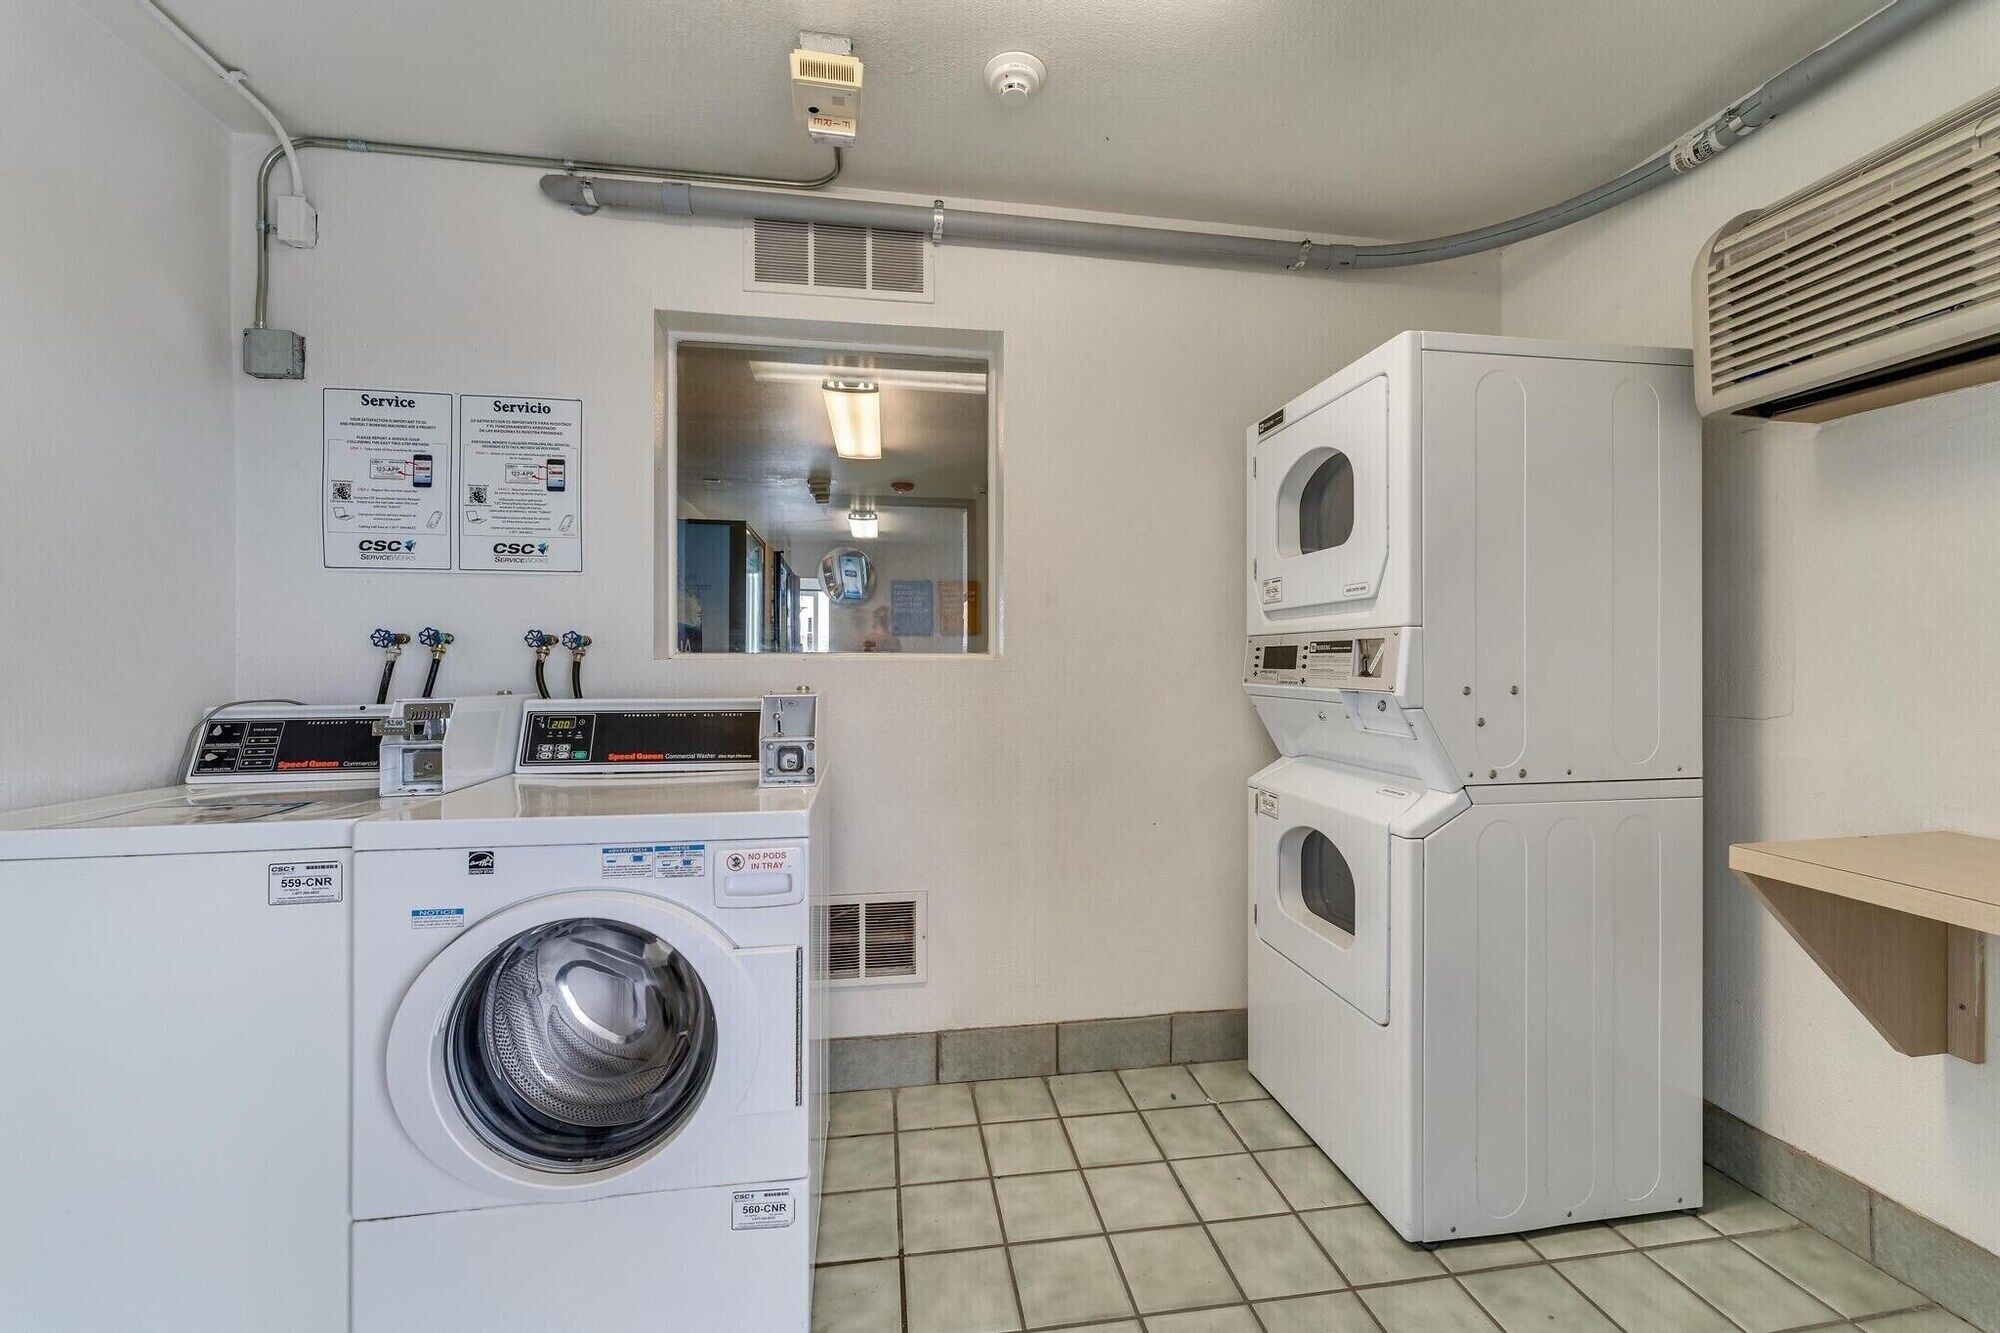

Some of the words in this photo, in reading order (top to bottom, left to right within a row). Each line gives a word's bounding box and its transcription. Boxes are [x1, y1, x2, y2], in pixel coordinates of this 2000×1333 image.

[360, 394, 416, 408] Service
[494, 400, 551, 414] Servicio
[359, 540, 402, 551] CSC
[493, 543, 535, 554] CSC
[277, 760, 308, 769] Speed
[281, 877, 332, 888] 559-CNR
[742, 1203, 787, 1214] 560-CNR
